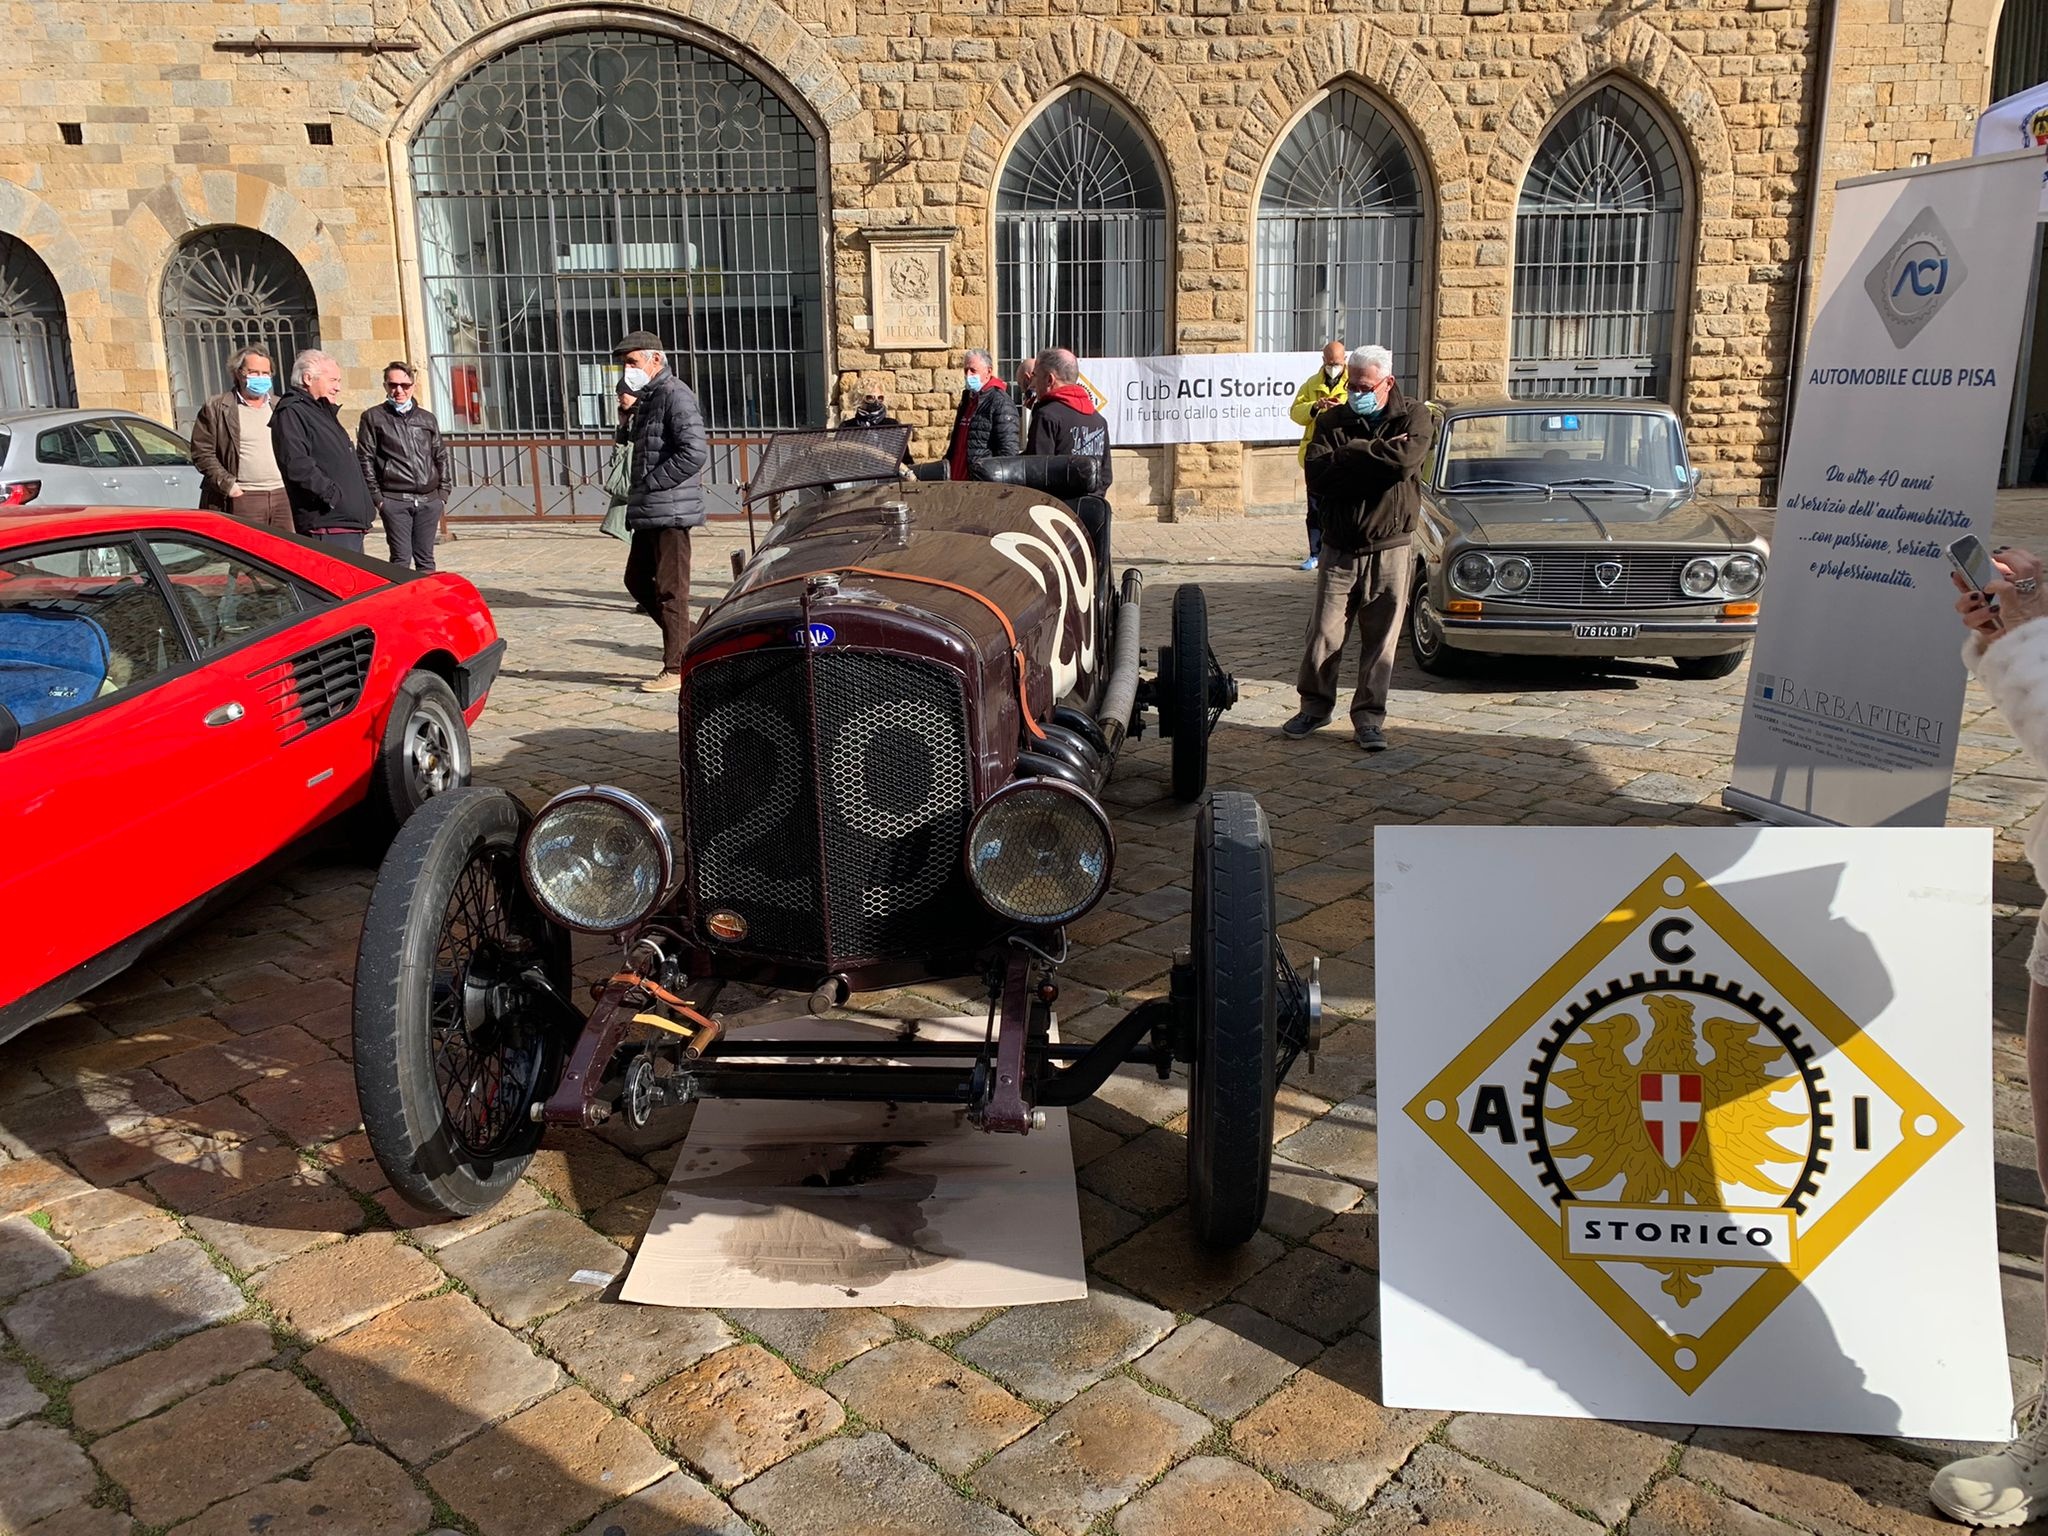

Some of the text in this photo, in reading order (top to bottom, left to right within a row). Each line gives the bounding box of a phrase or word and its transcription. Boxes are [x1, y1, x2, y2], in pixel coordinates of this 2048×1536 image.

[1891, 258, 1949, 297] ACI
[1126, 376, 1296, 402] Club ACI Storico
[1808, 368, 1997, 387] AUTOMOBILE CLUB PISA
[1126, 408, 1133, 422] Il
[1137, 407, 1181, 422] futuro
[1184, 404, 1218, 420] dallo
[1222, 404, 1251, 419] stile
[1825, 464, 1936, 491] Da oltre 40 anni
[1786, 493, 1973, 529] al servizio dell'automobilista
[1809, 562, 1818, 573] e
[1579, 626, 1634, 637] 176140 PI
[1776, 676, 1944, 745] BARBAFIERI
[1583, 1219, 1774, 1248] STORICO
